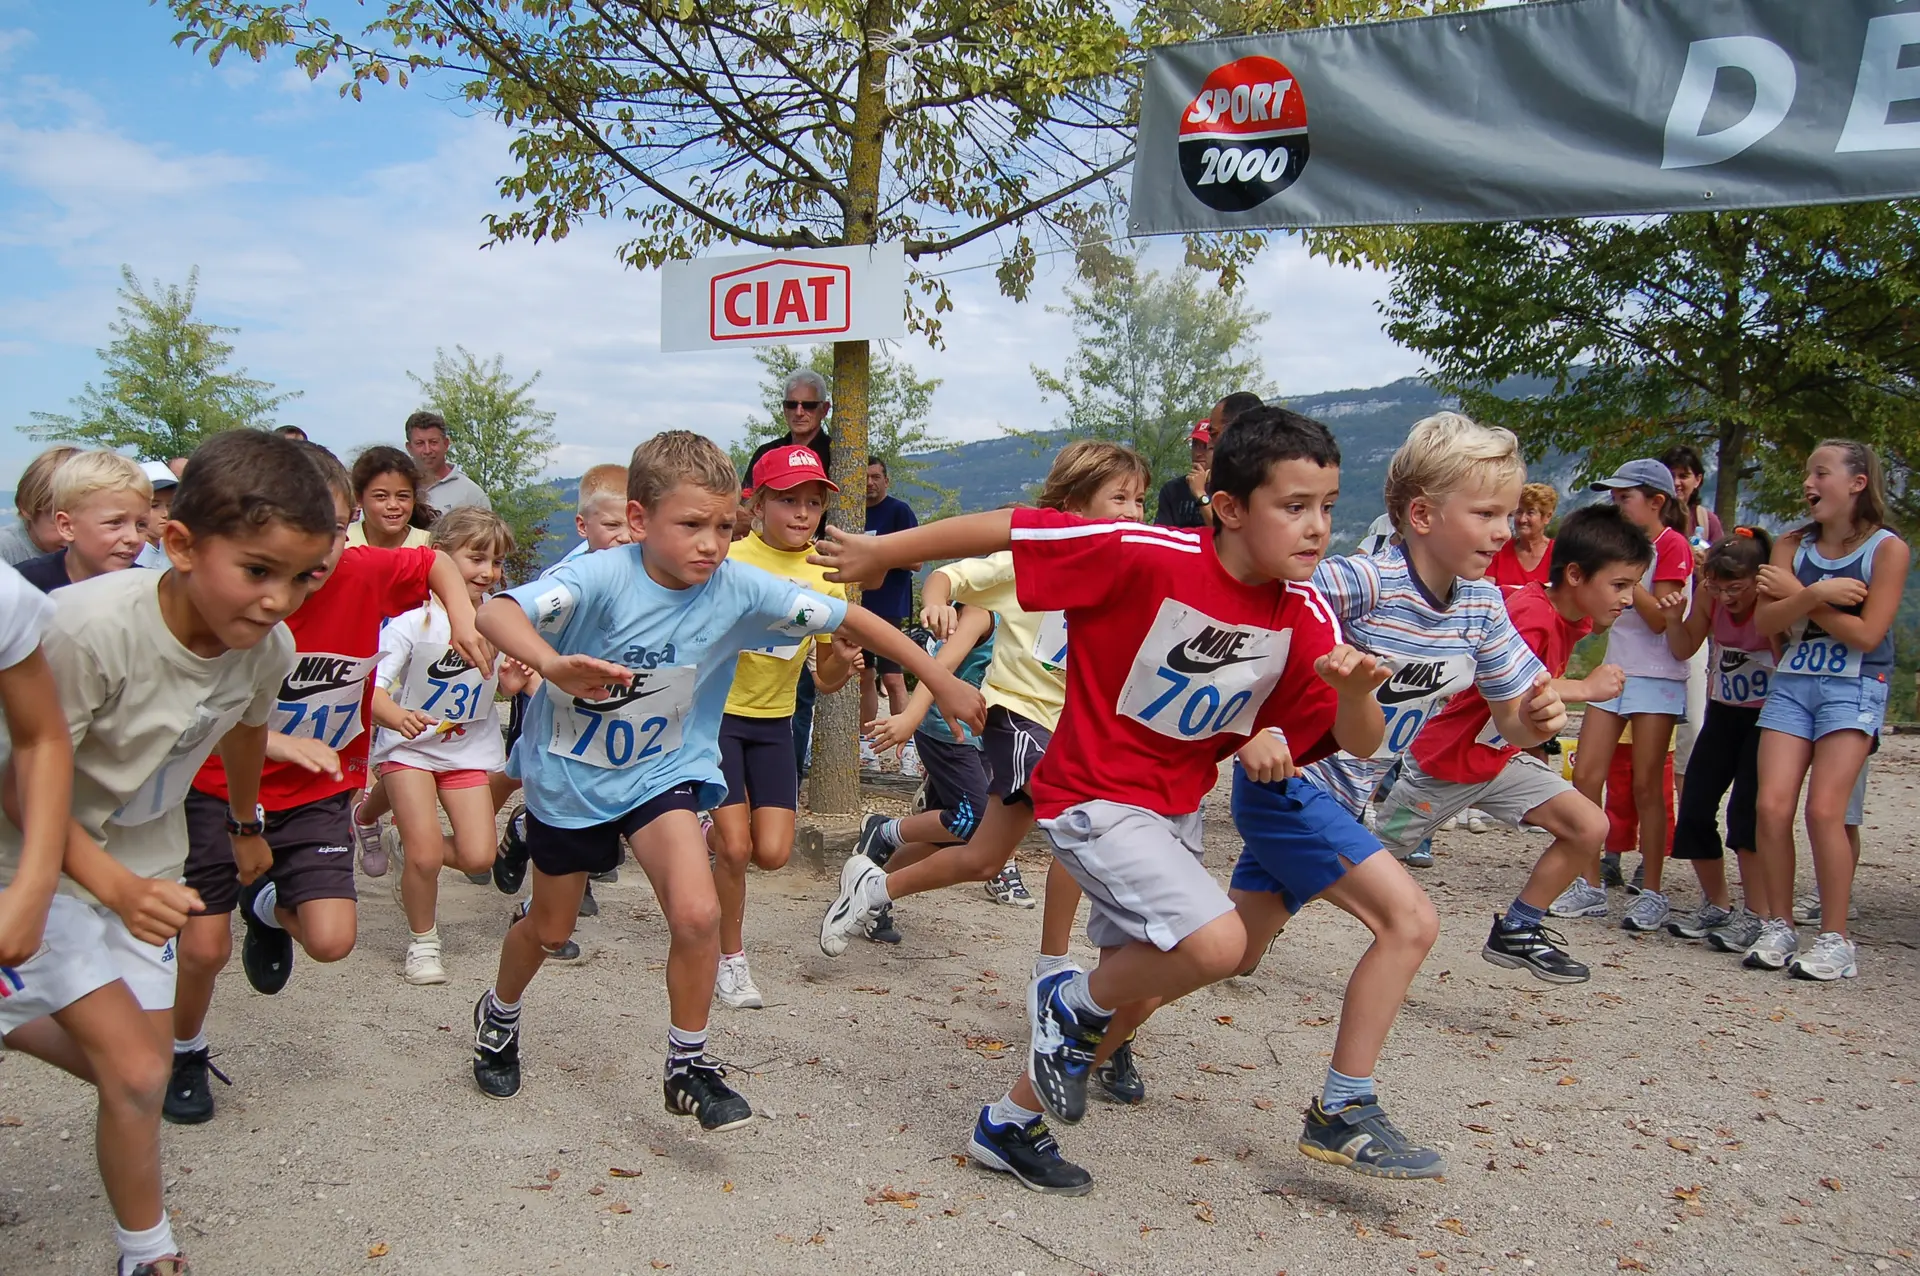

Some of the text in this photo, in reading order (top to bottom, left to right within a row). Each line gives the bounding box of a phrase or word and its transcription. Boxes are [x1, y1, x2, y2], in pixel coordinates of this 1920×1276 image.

[1187, 79, 1292, 124] SPORT
[1197, 147, 1288, 185] 2000
[724, 276, 835, 327] CIAT
[439, 649, 468, 668] NI
[623, 643, 676, 670] asa
[1188, 625, 1250, 659] NIKE
[1790, 642, 1848, 673] 808
[290, 657, 356, 683] NIKE
[603, 673, 651, 698] KE
[1392, 661, 1446, 688] NIKE
[1721, 670, 1768, 701] 809
[421, 678, 482, 720] 731
[1137, 666, 1252, 736] 700
[277, 700, 360, 748] 717
[570, 707, 668, 766] 702
